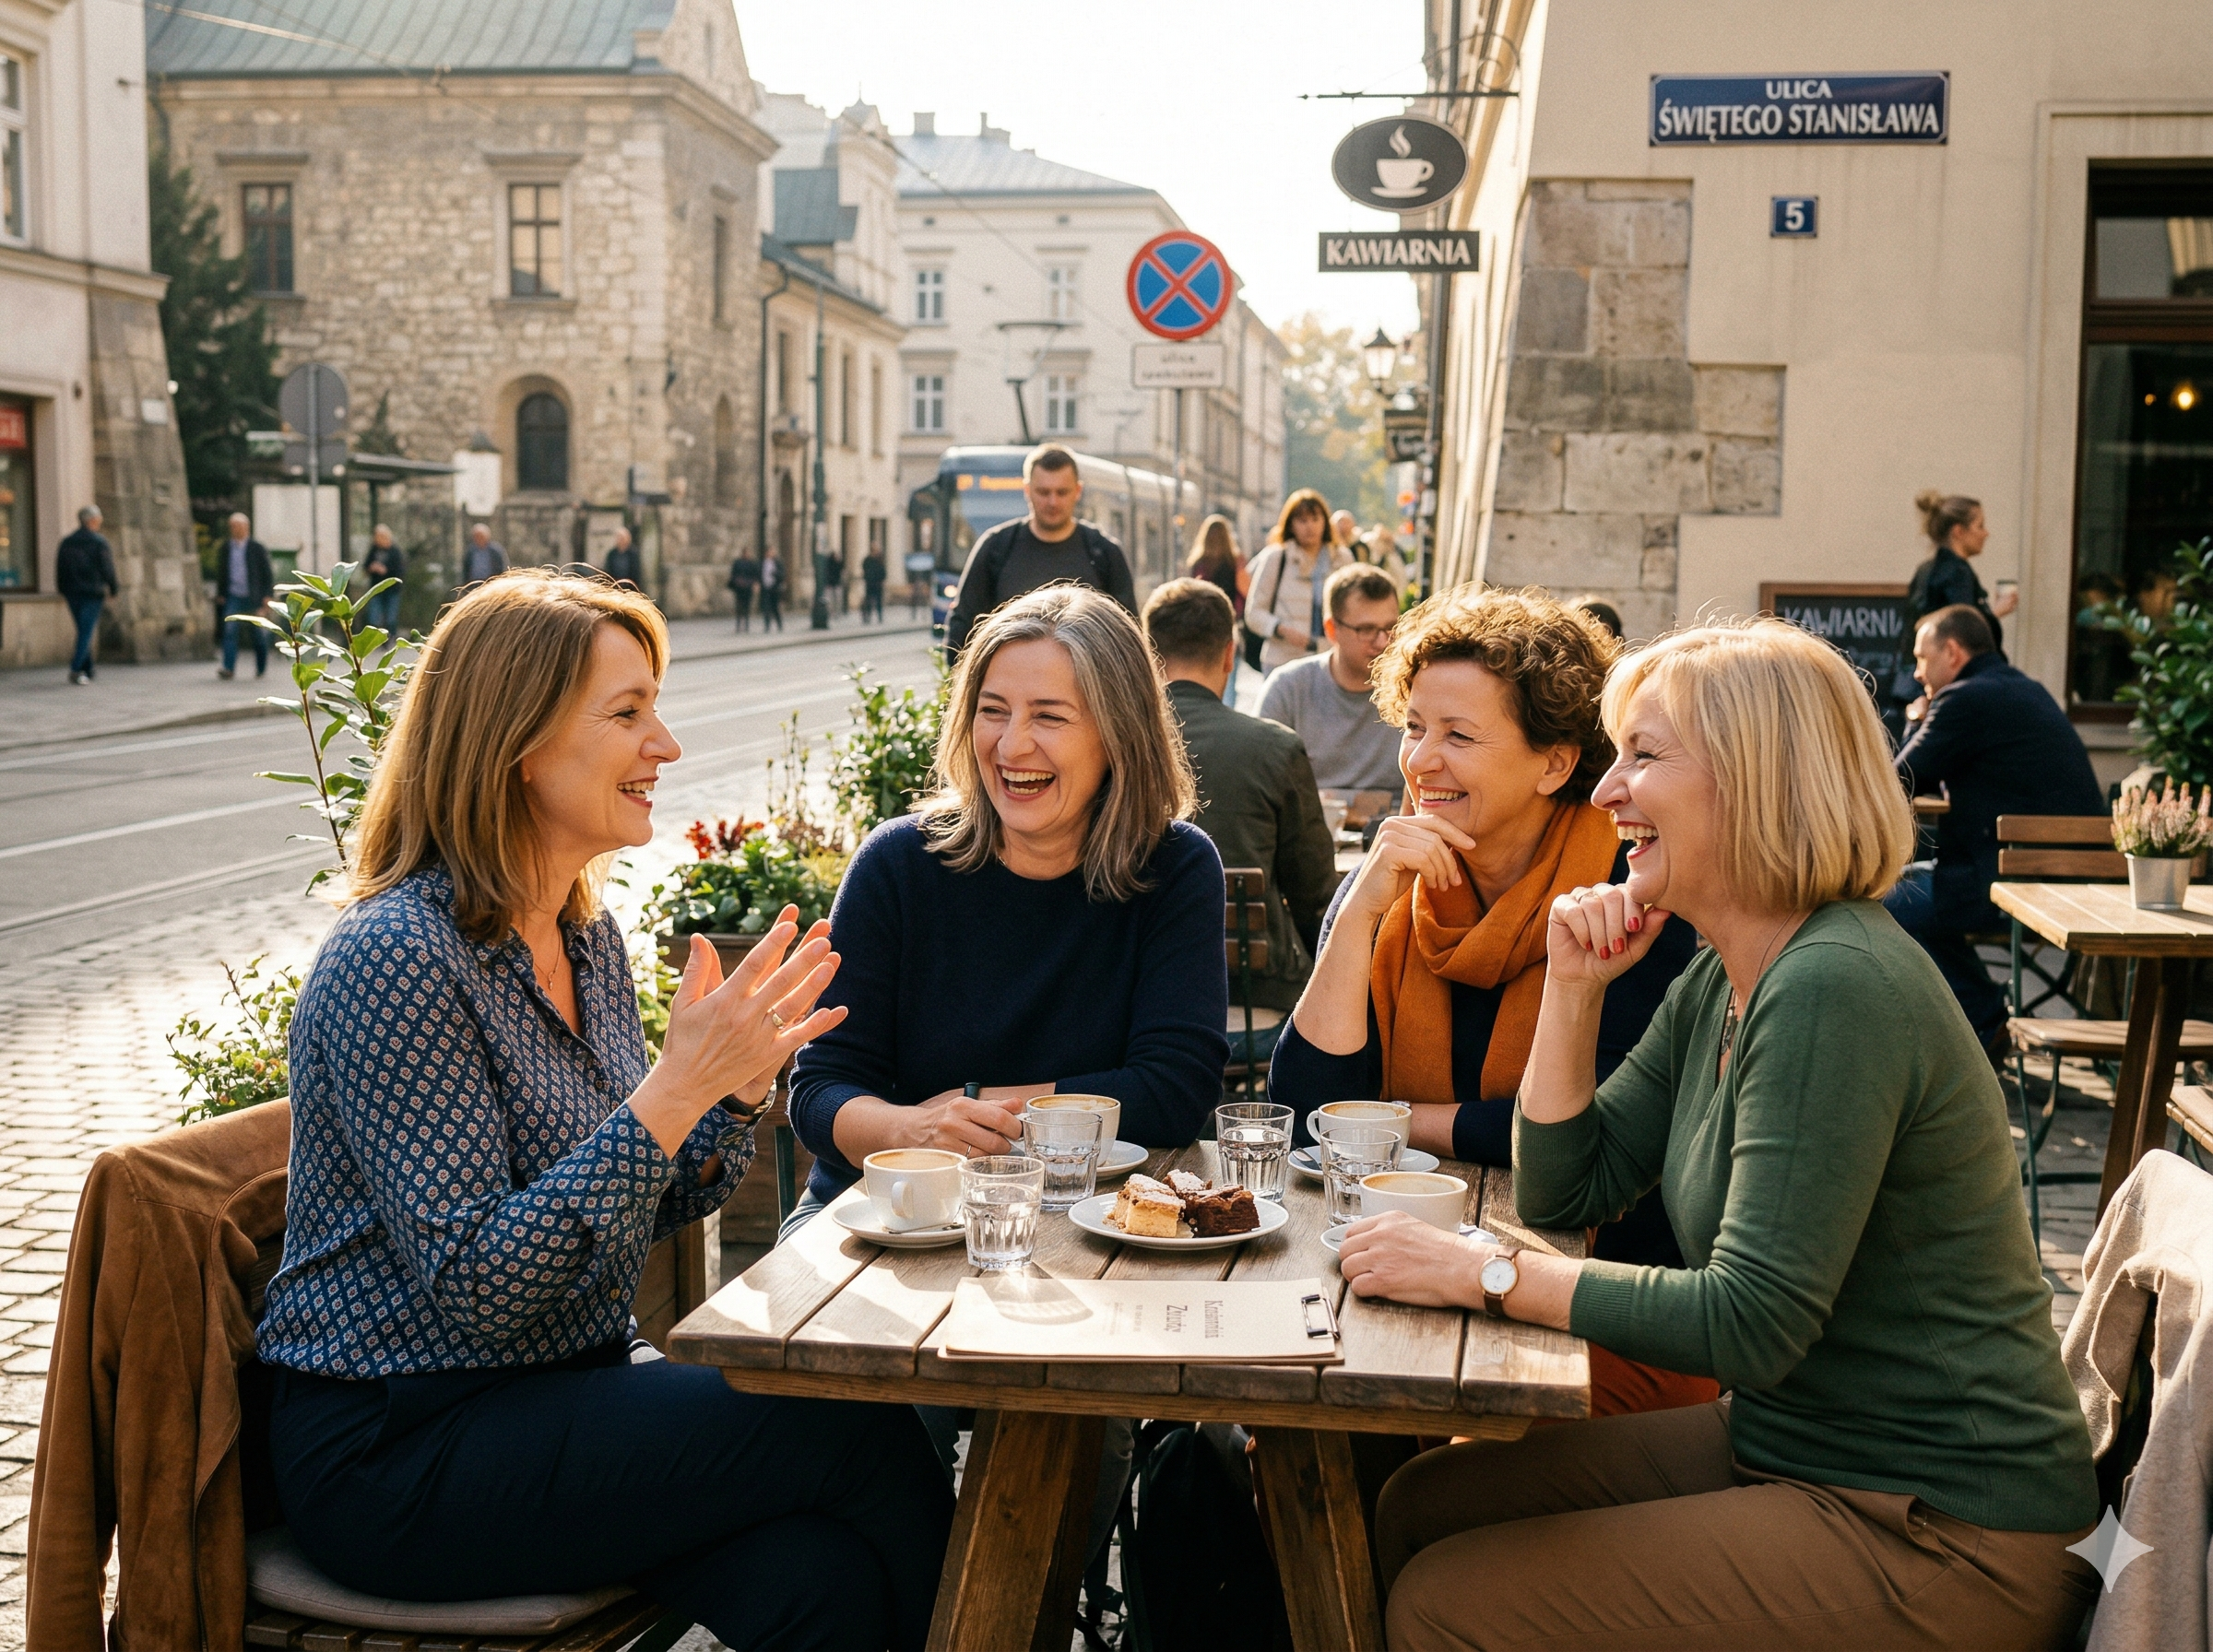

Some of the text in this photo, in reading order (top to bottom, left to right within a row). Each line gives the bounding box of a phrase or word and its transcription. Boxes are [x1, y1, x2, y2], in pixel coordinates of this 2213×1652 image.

[1766, 79, 1833, 100] ULICA
[1658, 99, 1940, 143] ŚWIĘTEGO STANISŁAWA
[1784, 201, 1805, 231] 5
[1325, 237, 1473, 266] KAWIARNIA
